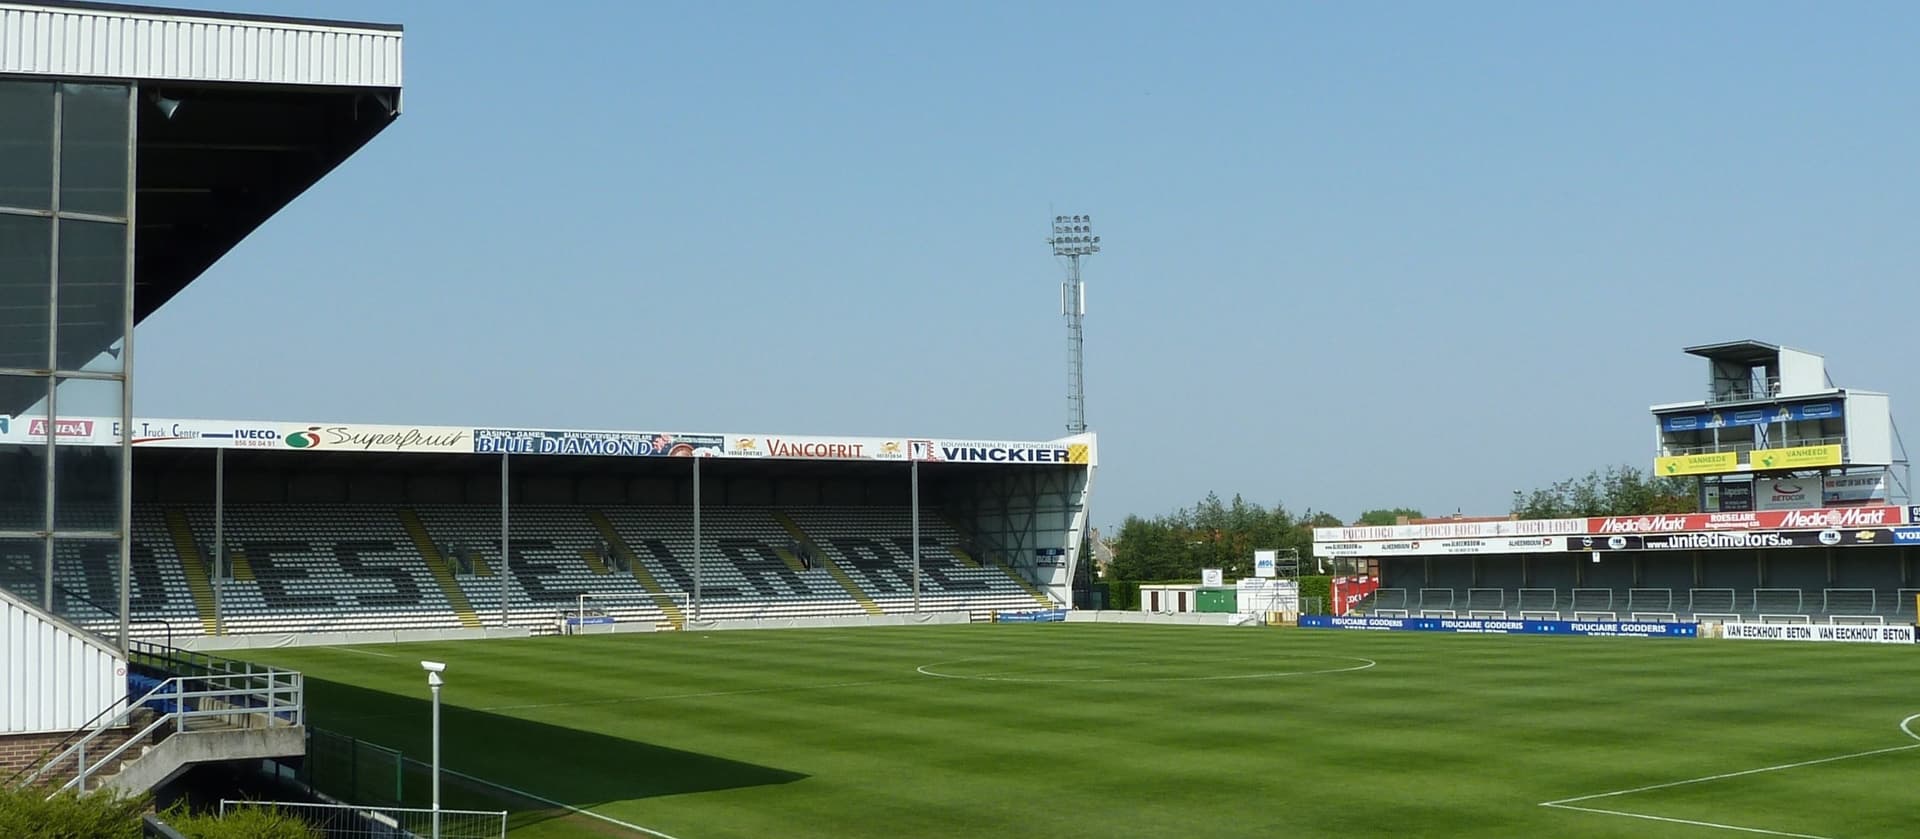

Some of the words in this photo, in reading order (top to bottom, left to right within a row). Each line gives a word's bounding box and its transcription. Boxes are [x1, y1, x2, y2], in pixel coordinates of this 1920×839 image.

[31, 421, 88, 435] AENA
[142, 423, 166, 437] Truck
[172, 424, 200, 439] Center
[326, 427, 470, 449] Superfruit
[478, 437, 534, 453] BLUE
[540, 437, 652, 456] DIAMOND
[766, 439, 863, 458] VANCOFRIT
[942, 448, 1070, 462] VINCKIER
[1600, 518, 1638, 533] Media
[1648, 517, 1686, 531] Markt
[1711, 513, 1755, 522] ROESELARE
[1780, 511, 1828, 527] Media
[1841, 509, 1885, 525] Markt
[1342, 528, 1366, 540] POCO
[1647, 531, 1793, 549] www.unitedmotors.be
[1332, 618, 1367, 626] FIDUCIAIRE
[1369, 619, 1403, 627] GODDERIS
[1484, 621, 1524, 630] GODDERIS
[1571, 623, 1618, 632] FIDUCIAIRE
[1621, 624, 1667, 633] GODDERIS
[1727, 626, 1741, 636] VAN
[1743, 626, 1782, 638] EECKHOUT
[1787, 628, 1811, 638] BETON
[1818, 627, 1834, 639] VAN
[1835, 628, 1878, 640] EECKHOUT
[1883, 629, 1911, 641] BETON
